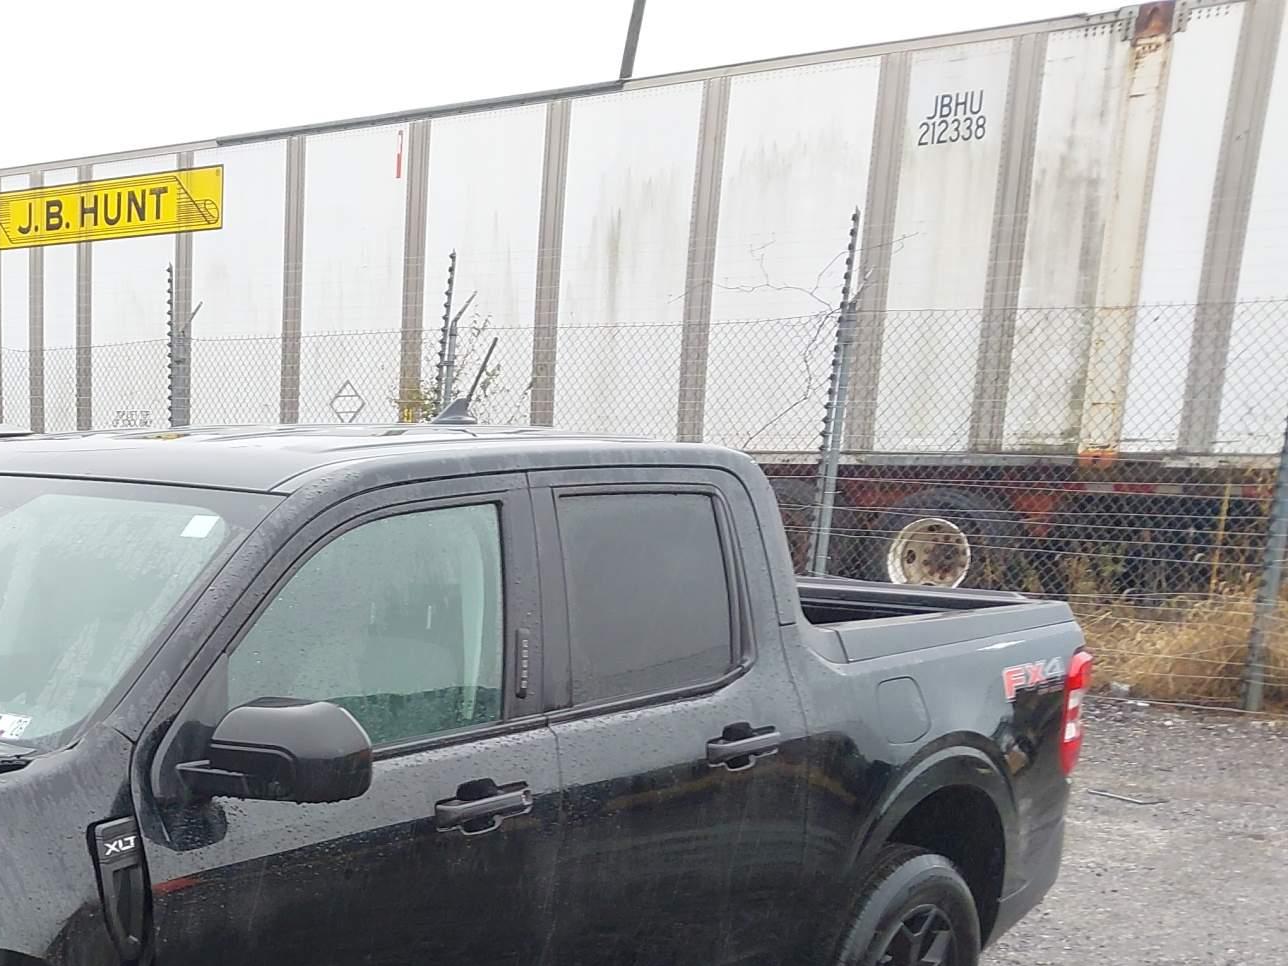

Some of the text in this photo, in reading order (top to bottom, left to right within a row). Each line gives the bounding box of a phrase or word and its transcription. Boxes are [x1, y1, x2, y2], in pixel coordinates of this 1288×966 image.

[926, 89, 984, 120] JBHU
[917, 115, 986, 146] 212338
[80, 186, 168, 228] HUNT
[1002, 656, 1065, 703] FX4
[103, 835, 137, 856] XLT
